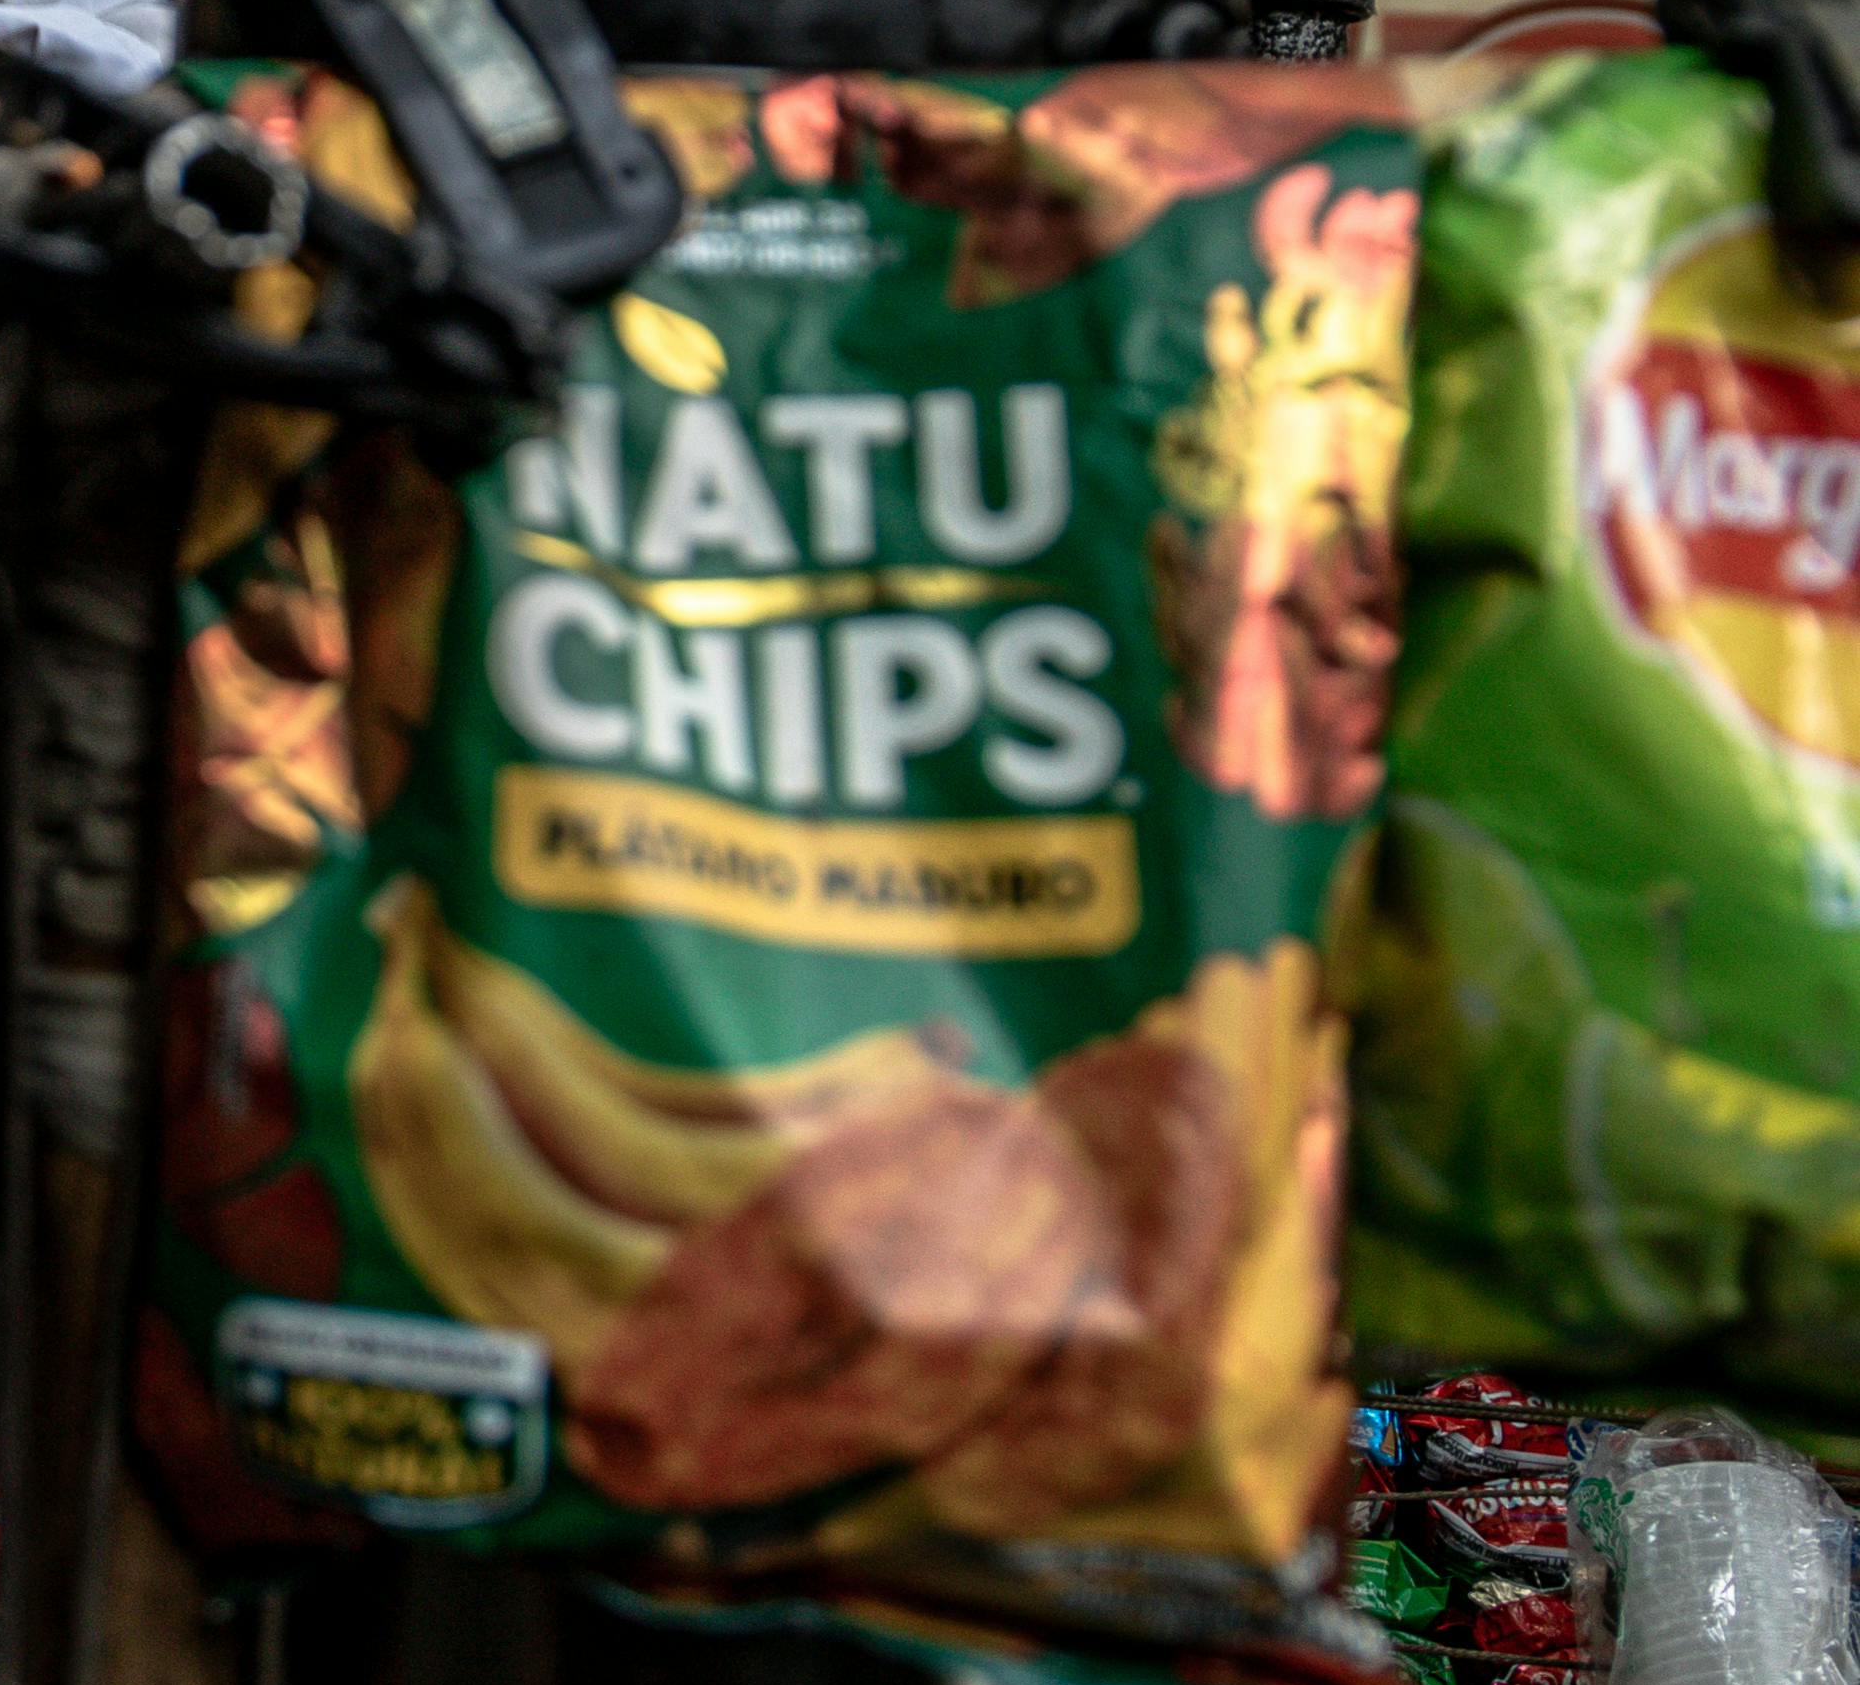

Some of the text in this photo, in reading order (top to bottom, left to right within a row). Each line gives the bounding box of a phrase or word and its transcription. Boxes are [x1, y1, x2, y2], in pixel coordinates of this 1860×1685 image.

[508, 382, 1072, 567] NATU
[1580, 378, 1860, 589] Marg
[485, 572, 1127, 808] CHIPS
